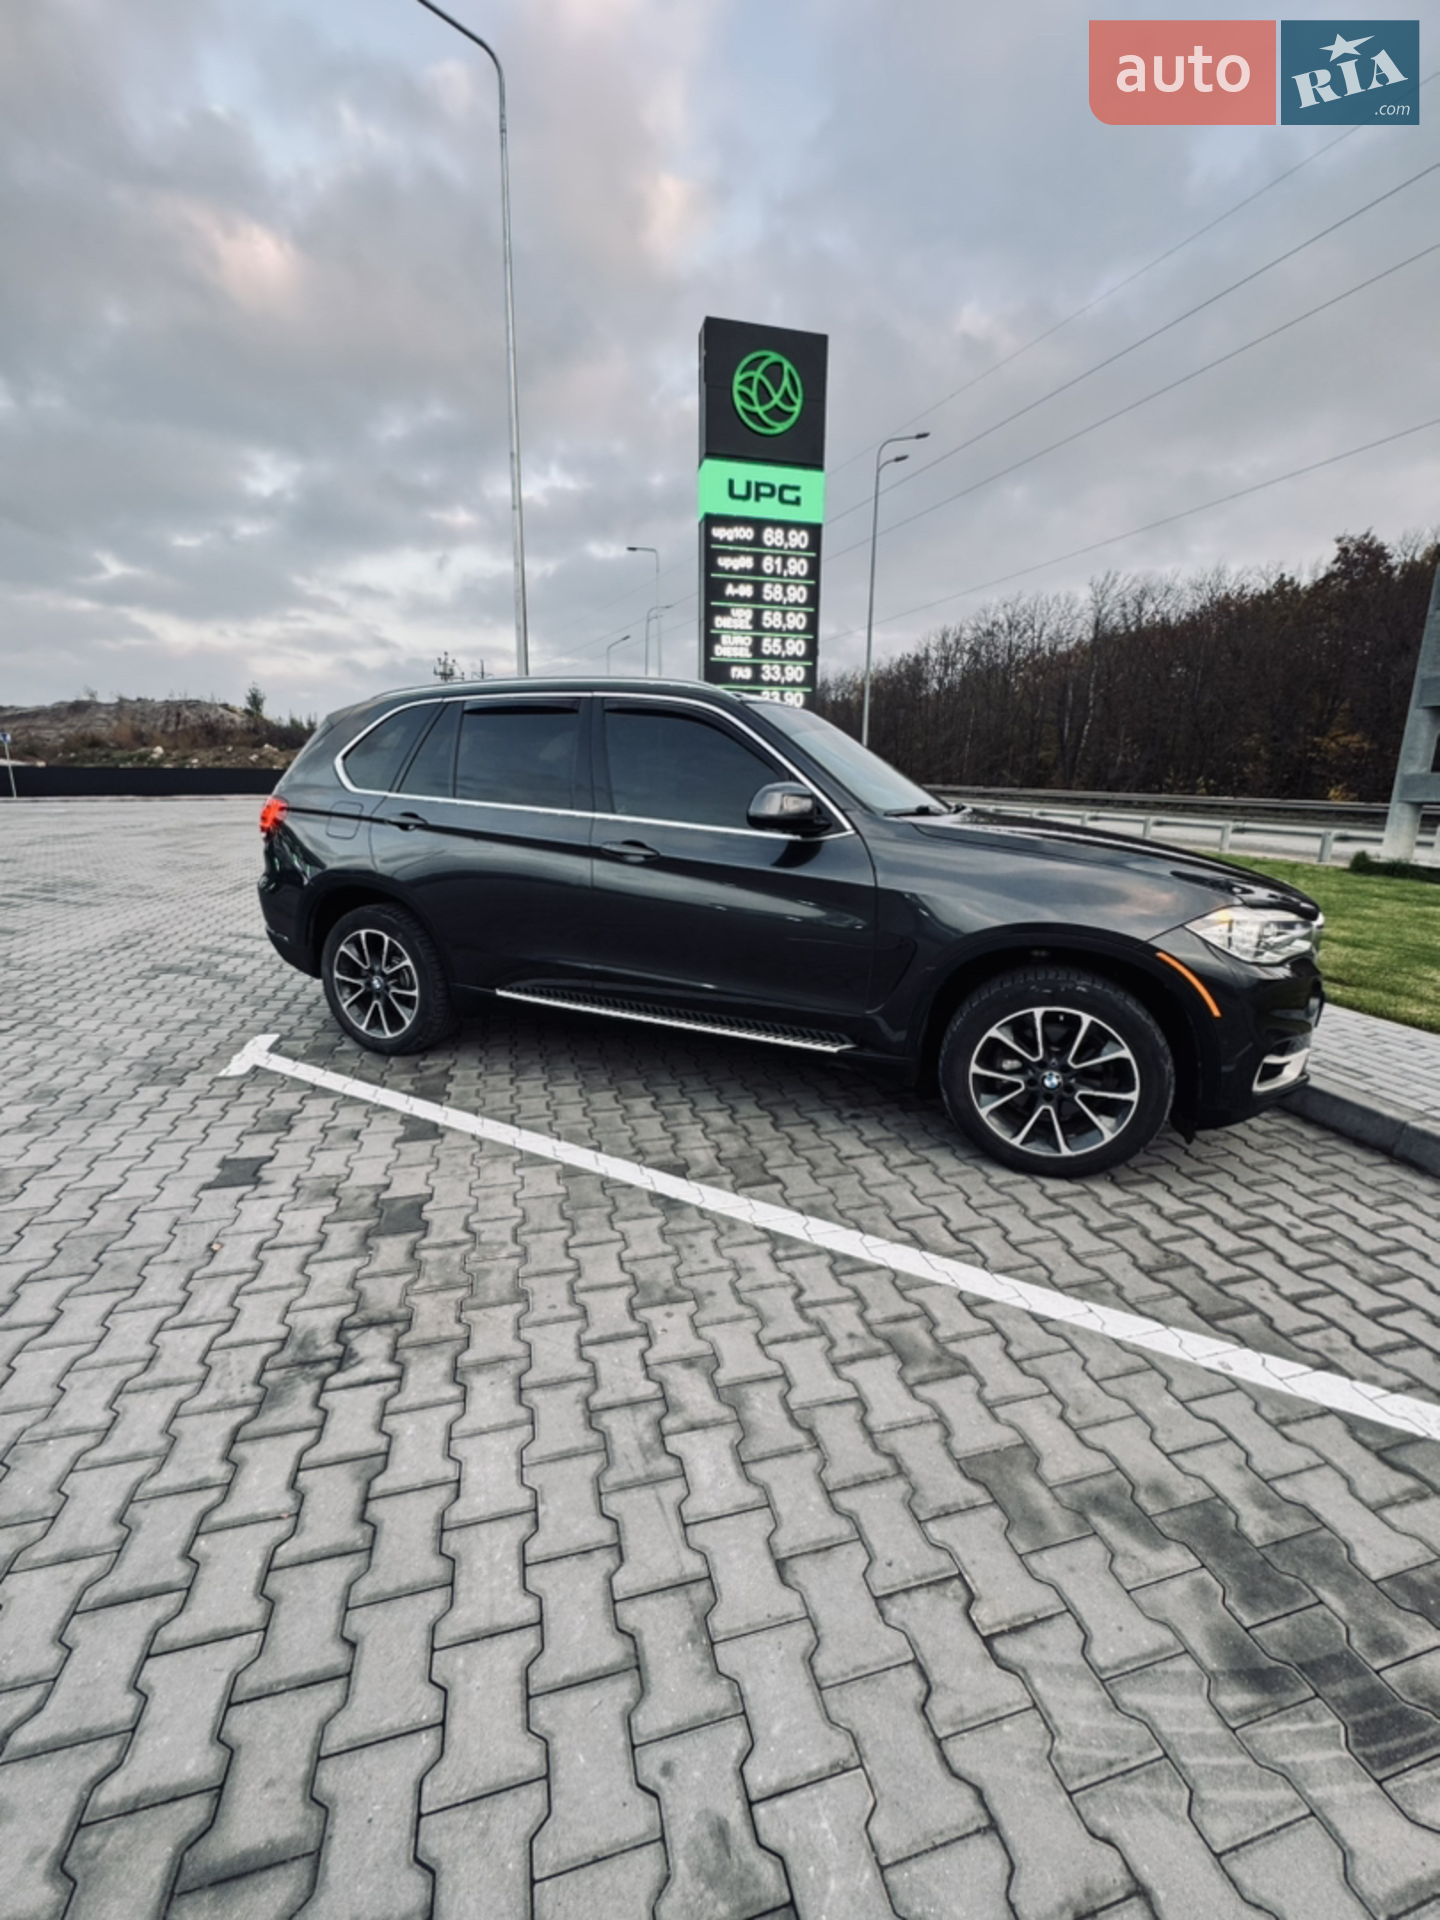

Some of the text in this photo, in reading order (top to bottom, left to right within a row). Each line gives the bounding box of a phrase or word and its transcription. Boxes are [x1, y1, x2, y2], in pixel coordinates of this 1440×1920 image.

[728, 478, 802, 506] UPG
[711, 527, 809, 549] upg100 68,90
[762, 555, 808, 577] 61,90
[762, 583, 807, 605] 58,90
[714, 610, 807, 631] DIESEL 58,90
[714, 637, 806, 658] DIESEL 55,90
[721, 634, 753, 646] EURO
[761, 664, 805, 685] 33,90
